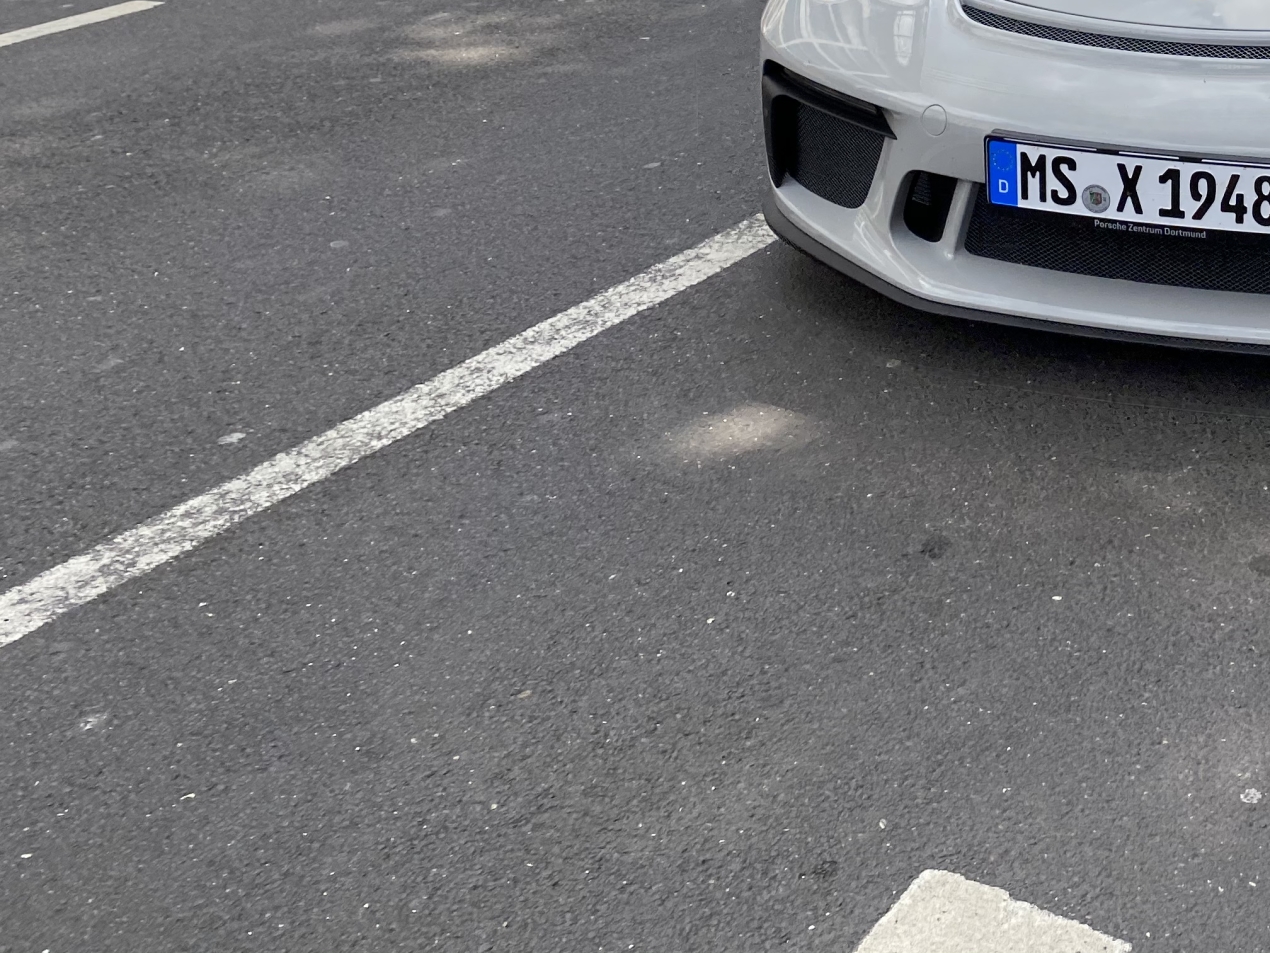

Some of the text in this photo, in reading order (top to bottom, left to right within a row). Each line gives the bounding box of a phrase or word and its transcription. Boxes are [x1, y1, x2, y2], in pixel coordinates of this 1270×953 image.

[998, 179, 1009, 193] D
[1020, 151, 1077, 206] MS
[1116, 162, 1143, 215] X
[1094, 219, 1207, 239] Porsche Zentrum Dortmund
